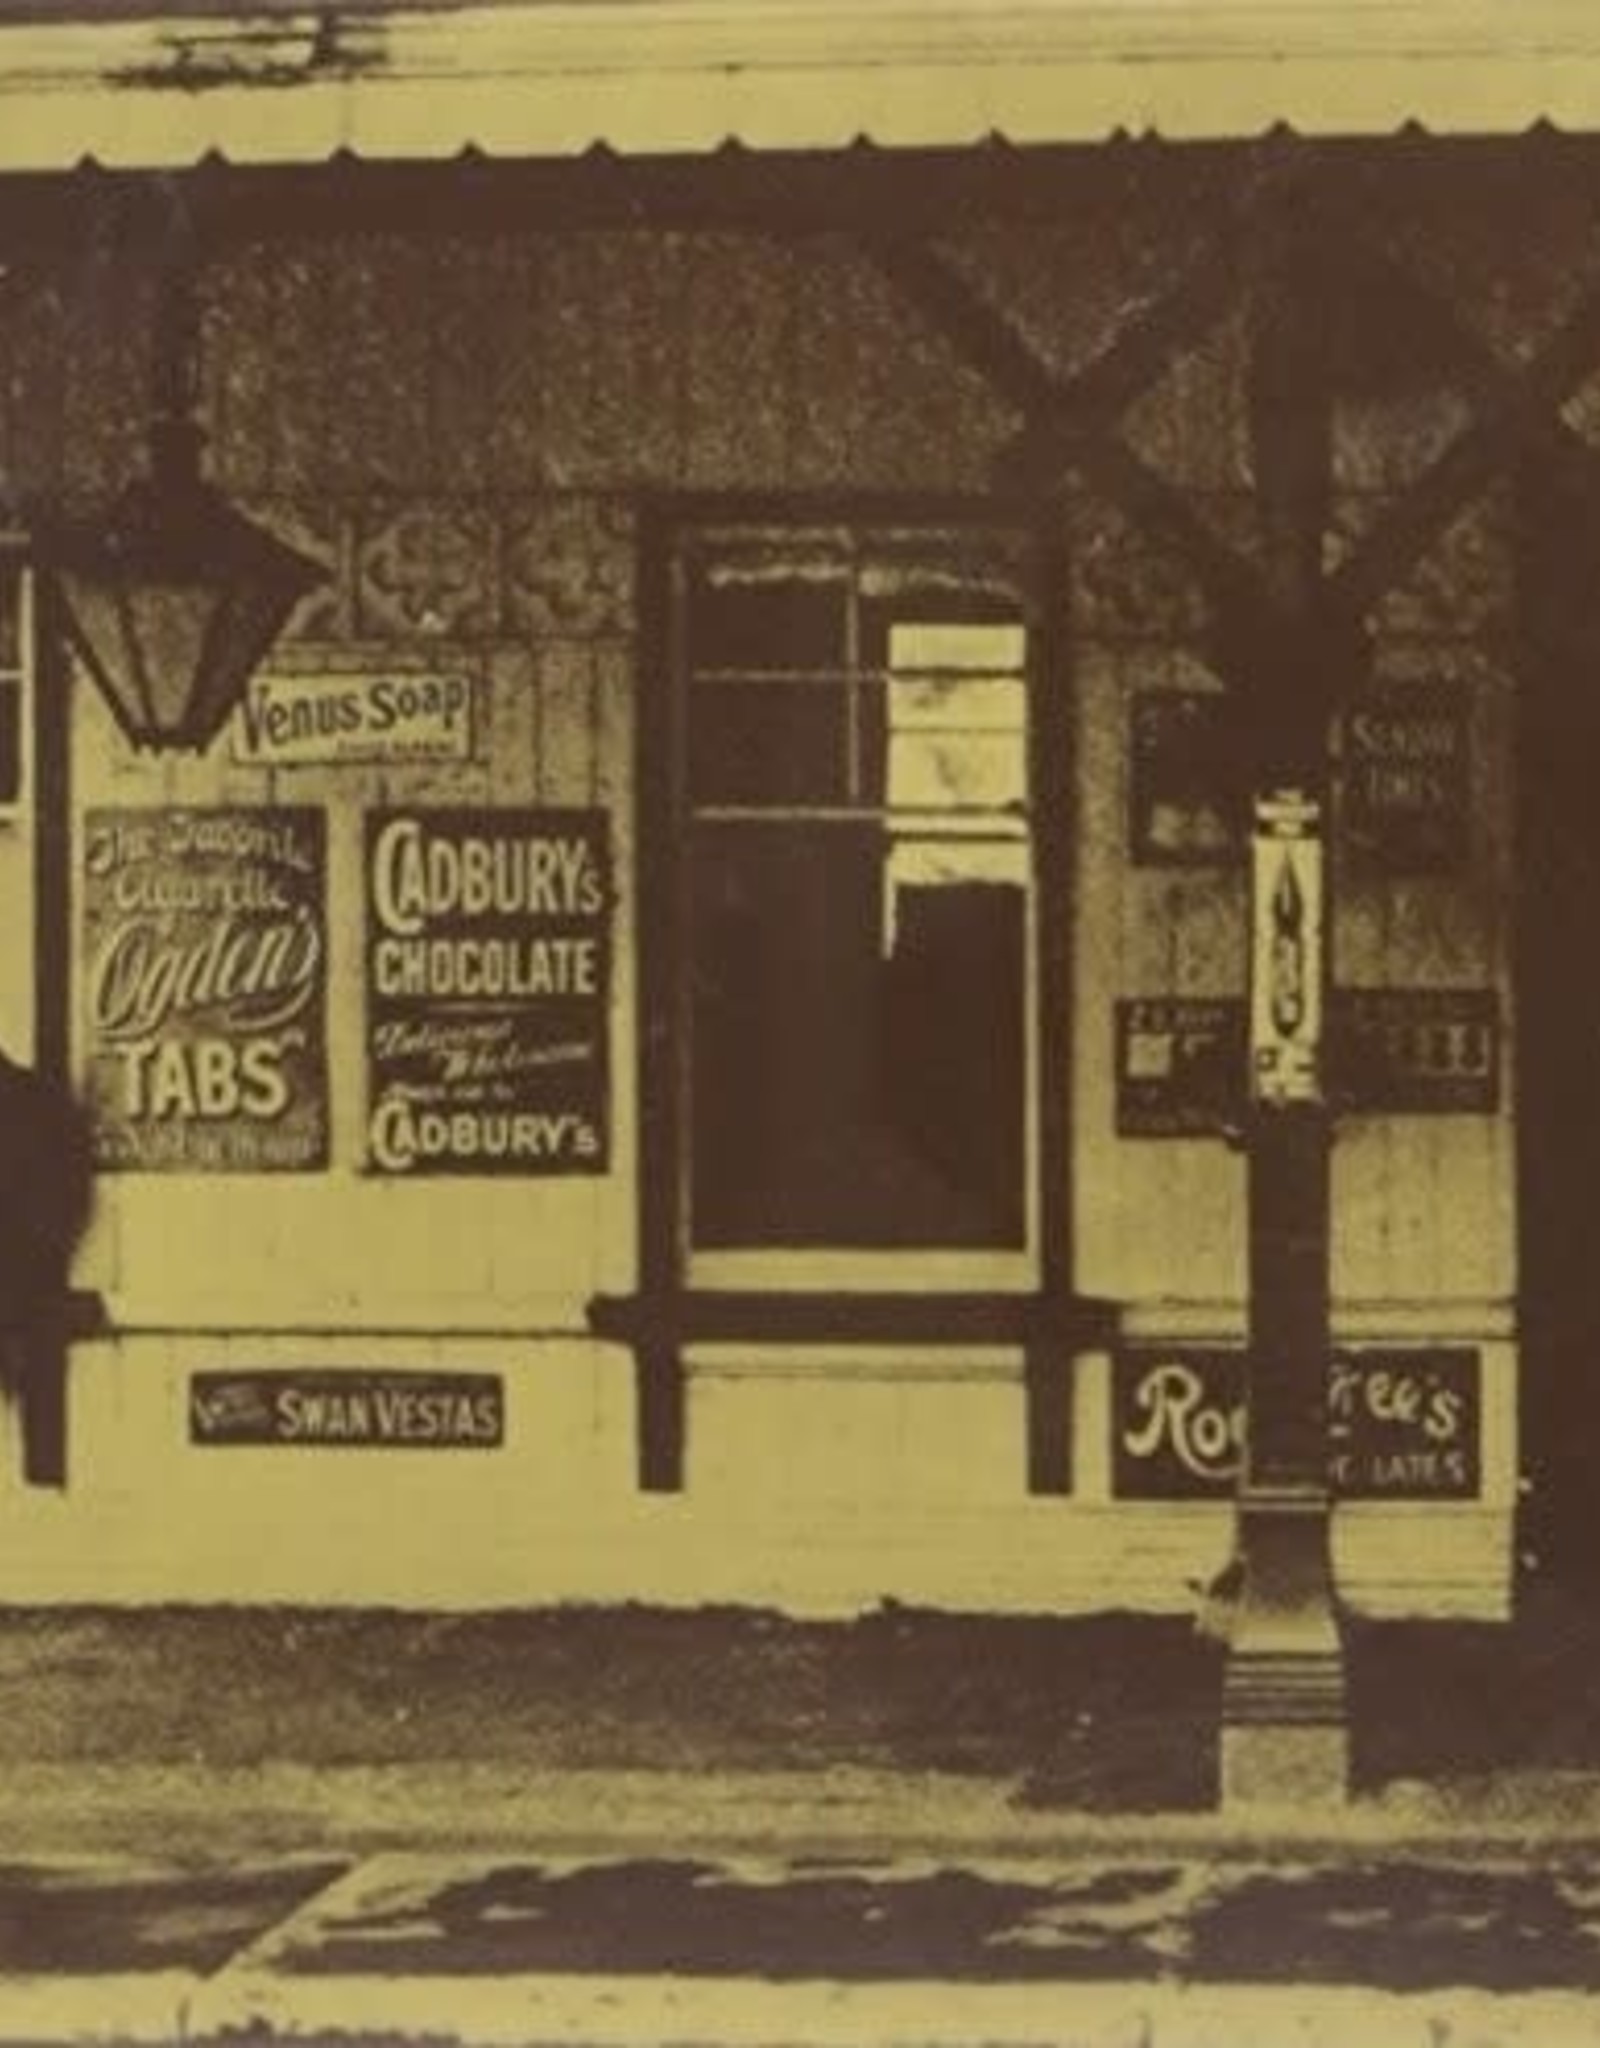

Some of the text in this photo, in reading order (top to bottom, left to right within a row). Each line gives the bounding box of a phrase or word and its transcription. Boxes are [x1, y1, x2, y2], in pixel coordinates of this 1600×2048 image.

[244, 680, 464, 754] Venus Soap
[376, 938, 597, 995] CHOCOLATE
[112, 1039, 289, 1118] TABS
[276, 1389, 371, 1437] SWAN
[374, 1387, 499, 1438] VESTAS
